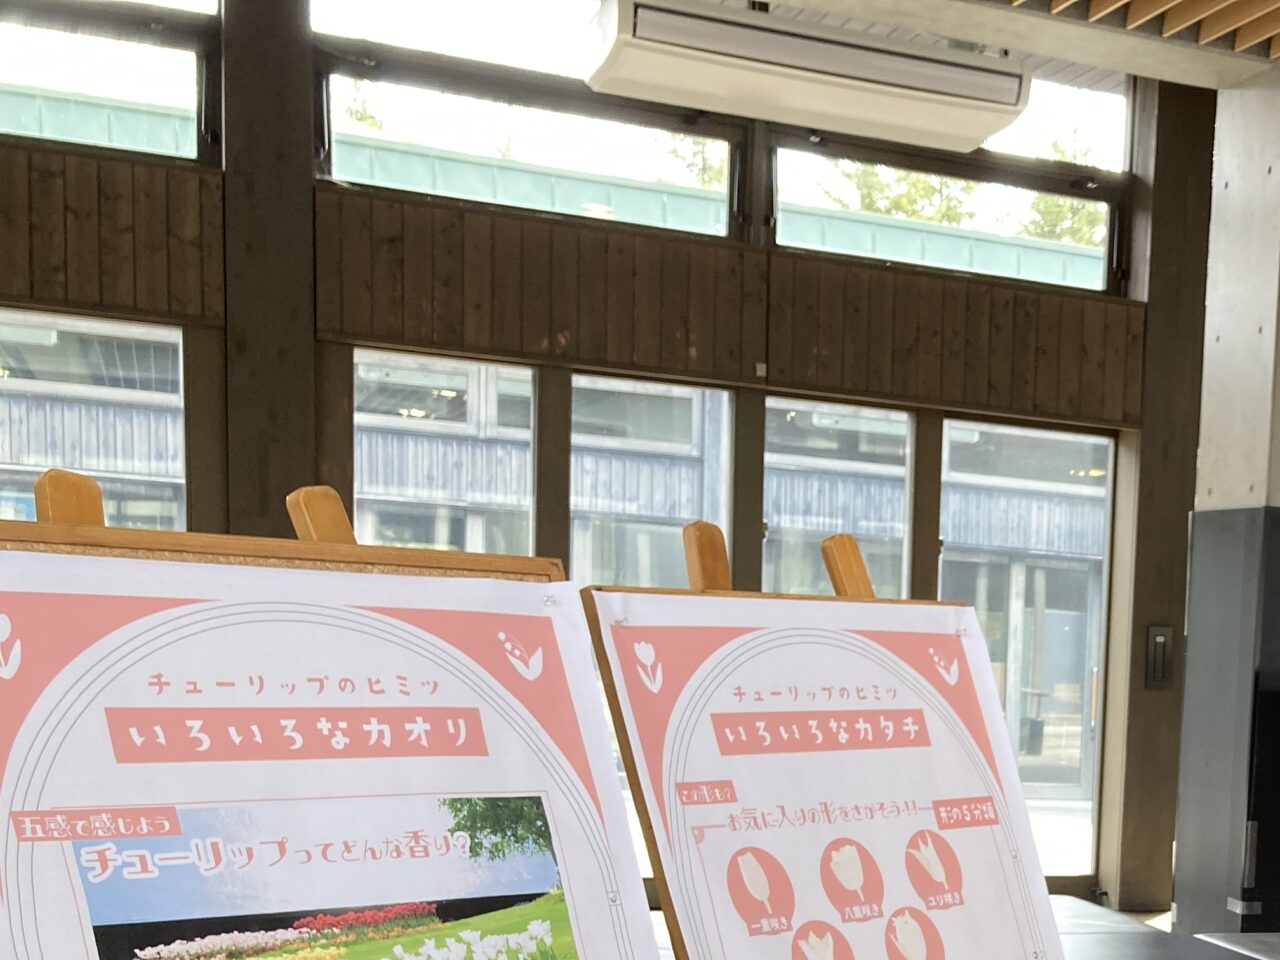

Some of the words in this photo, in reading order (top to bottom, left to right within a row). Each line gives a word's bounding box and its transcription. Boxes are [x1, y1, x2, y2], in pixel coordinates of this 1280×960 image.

[148, 674, 440, 696] チューリップのヒミツ
[732, 684, 899, 704] チューリップのヒミツ
[129, 716, 468, 751] いろいろなカオリ
[724, 717, 920, 746] いろいろなカタチ
[939, 801, 995, 823] 形の5分類
[20, 815, 172, 838] 五感で感じよう
[82, 829, 472, 879] チューリップってどんな香り?
[928, 891, 960, 906] ユリ咲き
[751, 916, 788, 931] 一重咲き
[844, 905, 880, 920] 八重咲き
